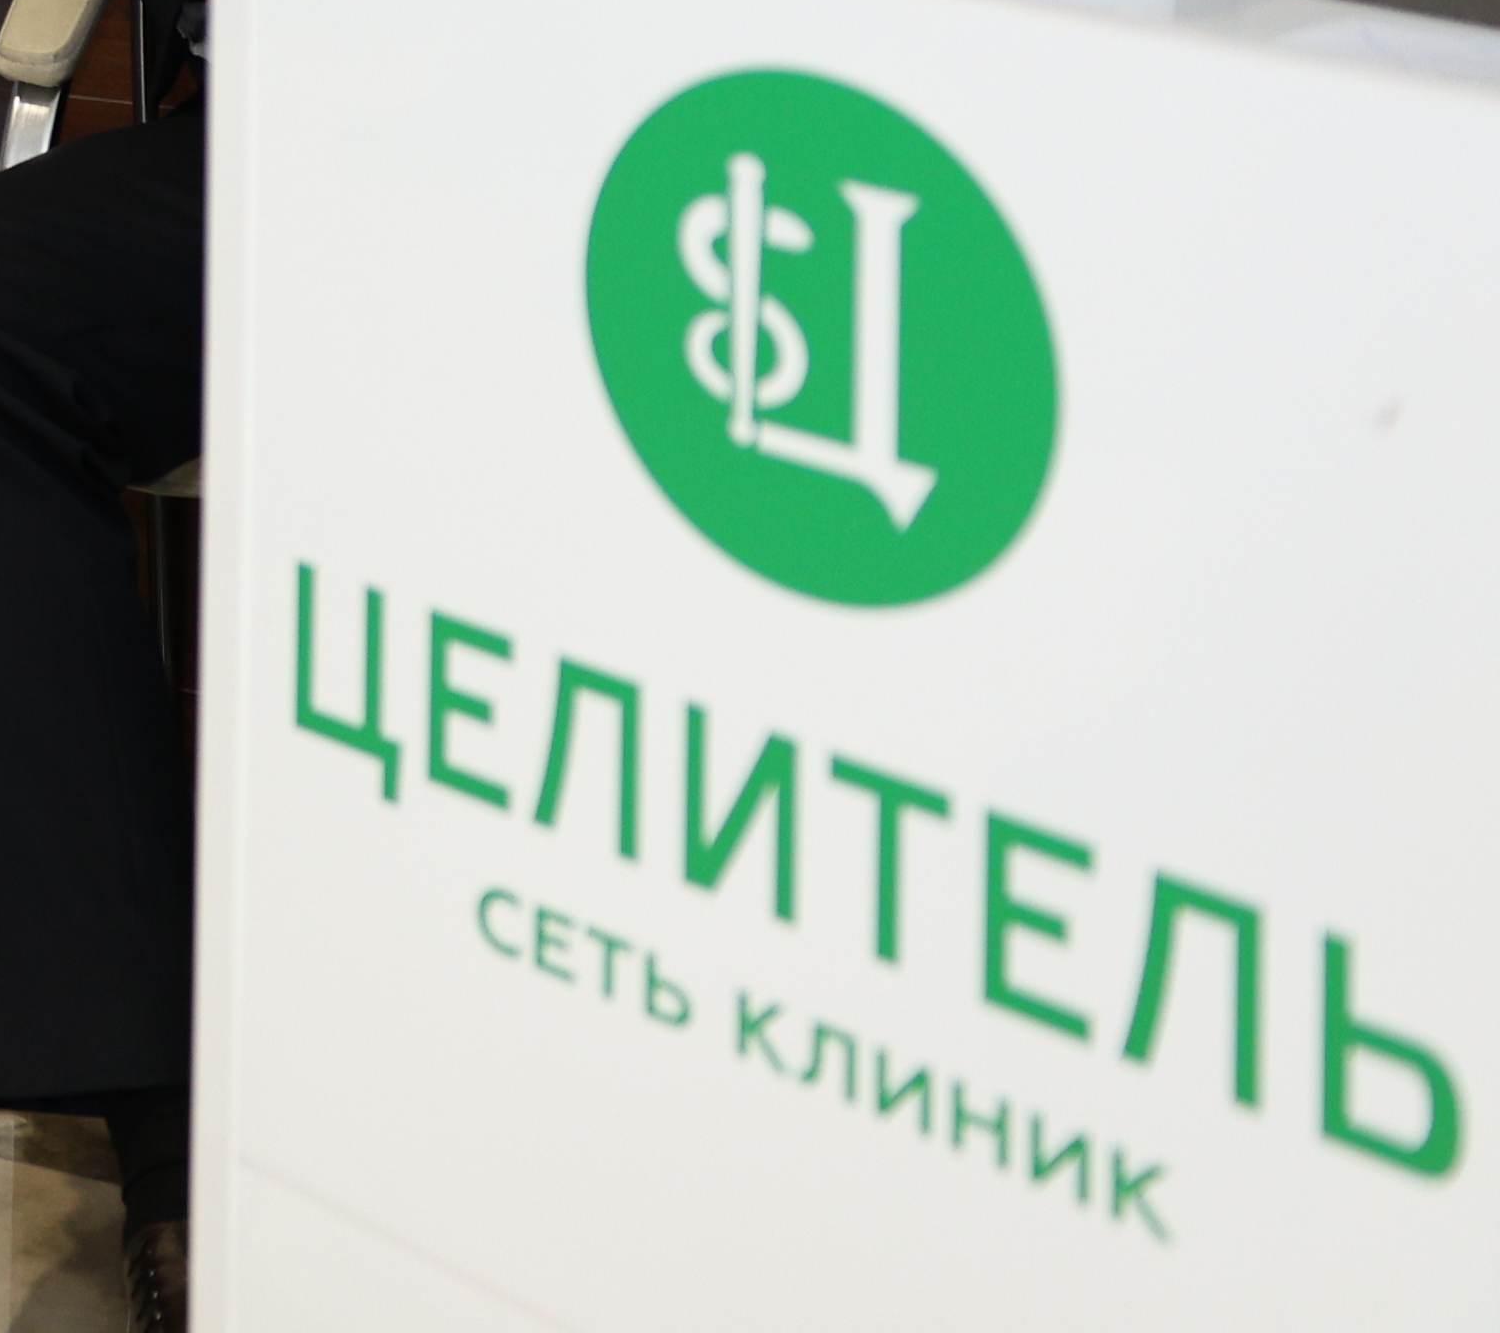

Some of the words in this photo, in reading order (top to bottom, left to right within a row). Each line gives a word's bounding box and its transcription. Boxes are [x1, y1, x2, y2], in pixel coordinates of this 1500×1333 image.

[293, 558, 1467, 1185] ЦЕЛИТЕЛЬ
[473, 884, 695, 1030] СЕТЬ
[734, 985, 1176, 1245] КЛИНИК
